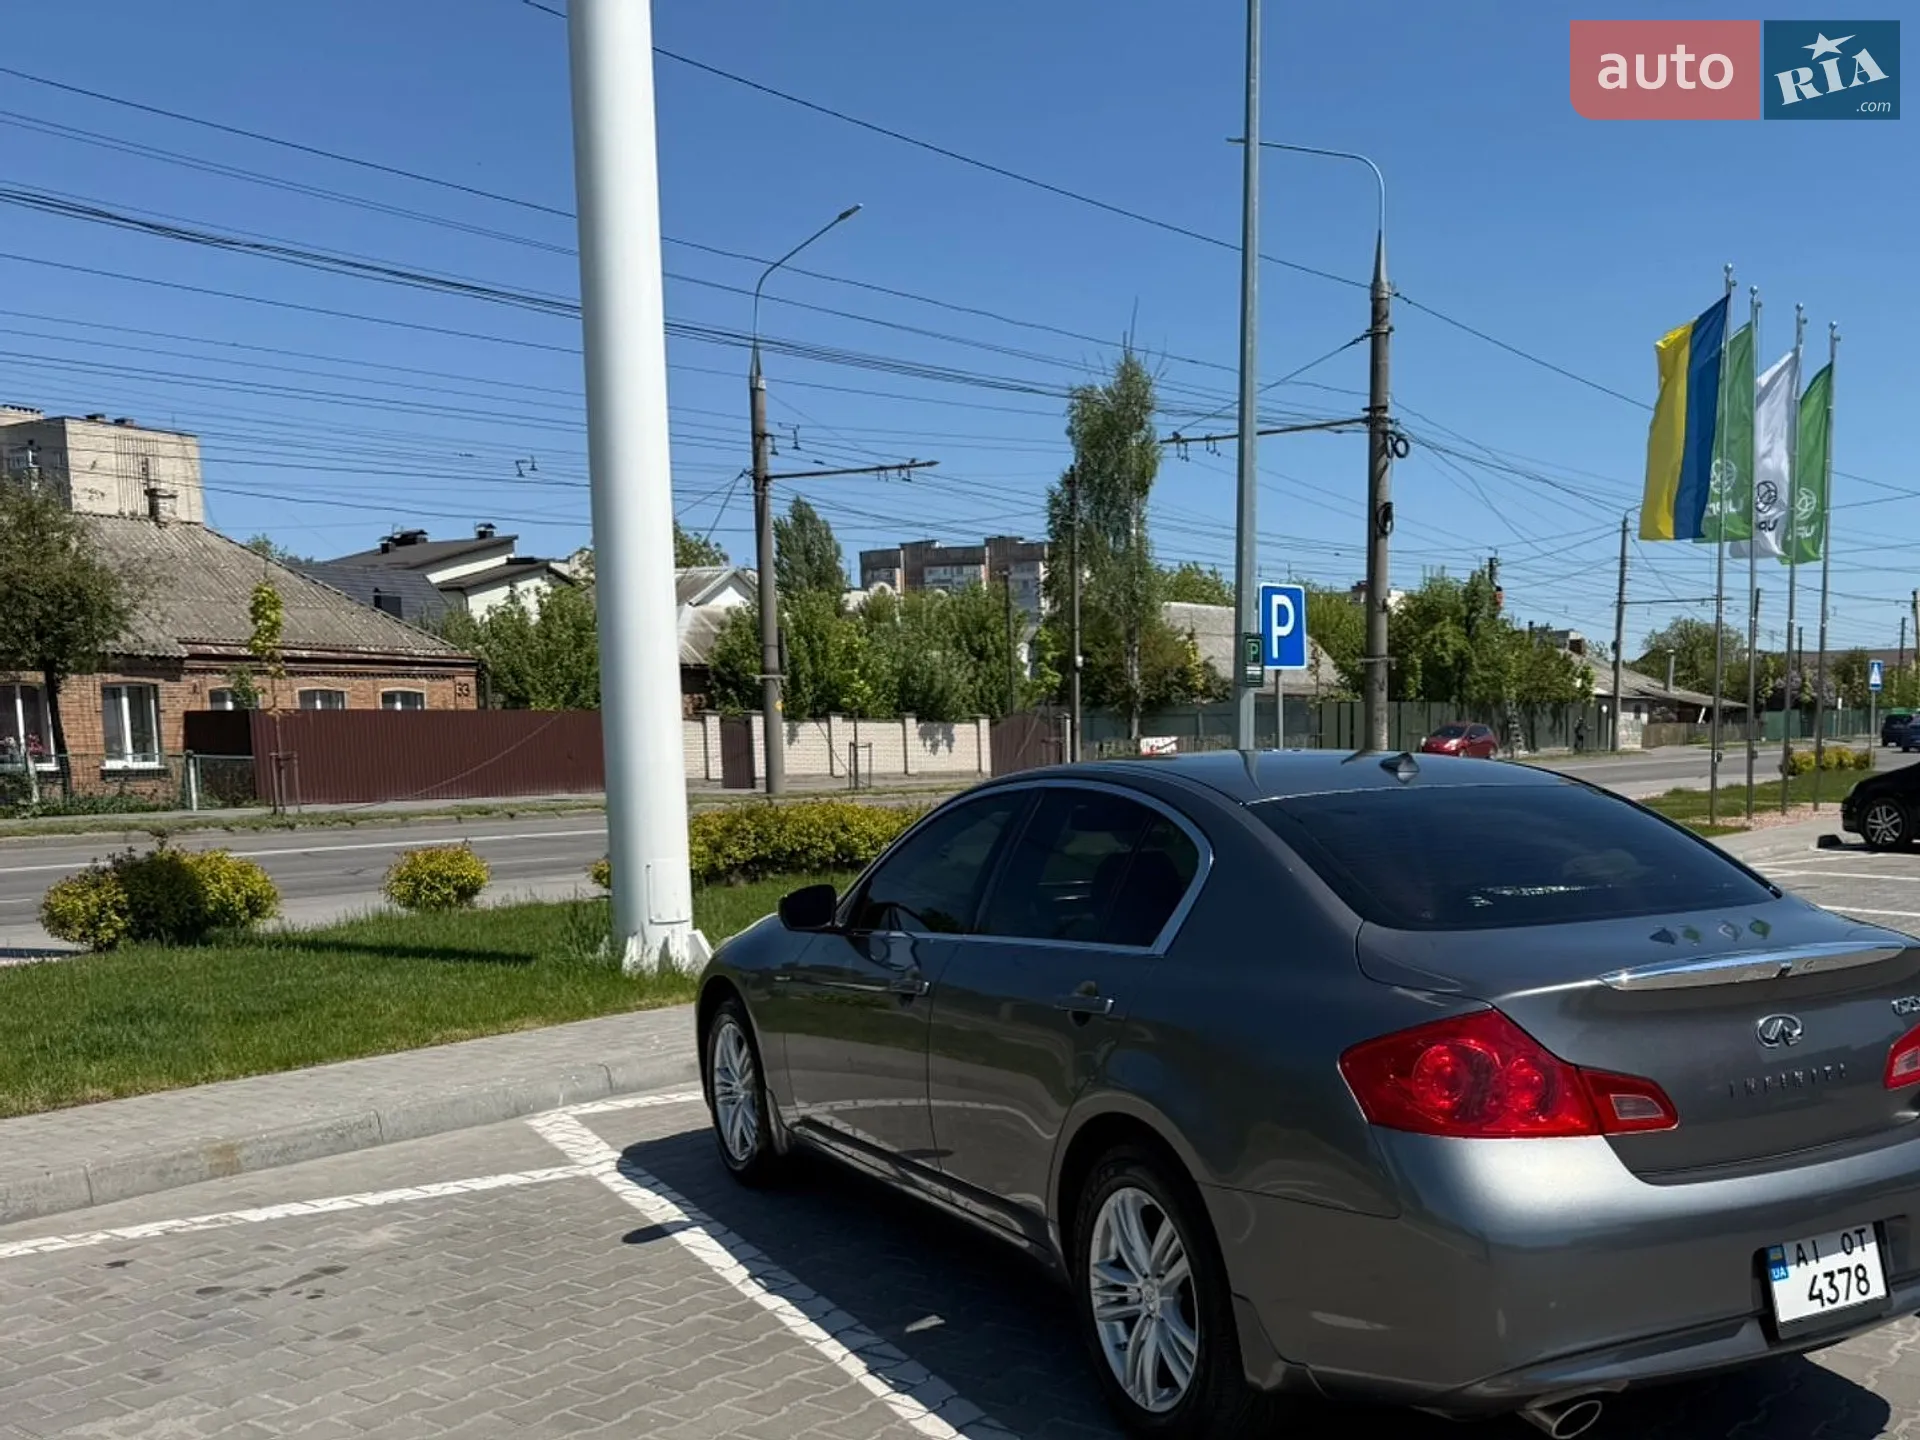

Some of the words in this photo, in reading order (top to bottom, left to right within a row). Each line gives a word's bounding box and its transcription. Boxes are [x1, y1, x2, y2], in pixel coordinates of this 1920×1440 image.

[1271, 594, 1295, 659] P
[1728, 1062, 1847, 1098] INFINITI
[1795, 1240, 1820, 1268] AI
[1840, 1228, 1867, 1256] OT
[1771, 1267, 1788, 1281] UA
[1807, 1263, 1871, 1307] 4378
